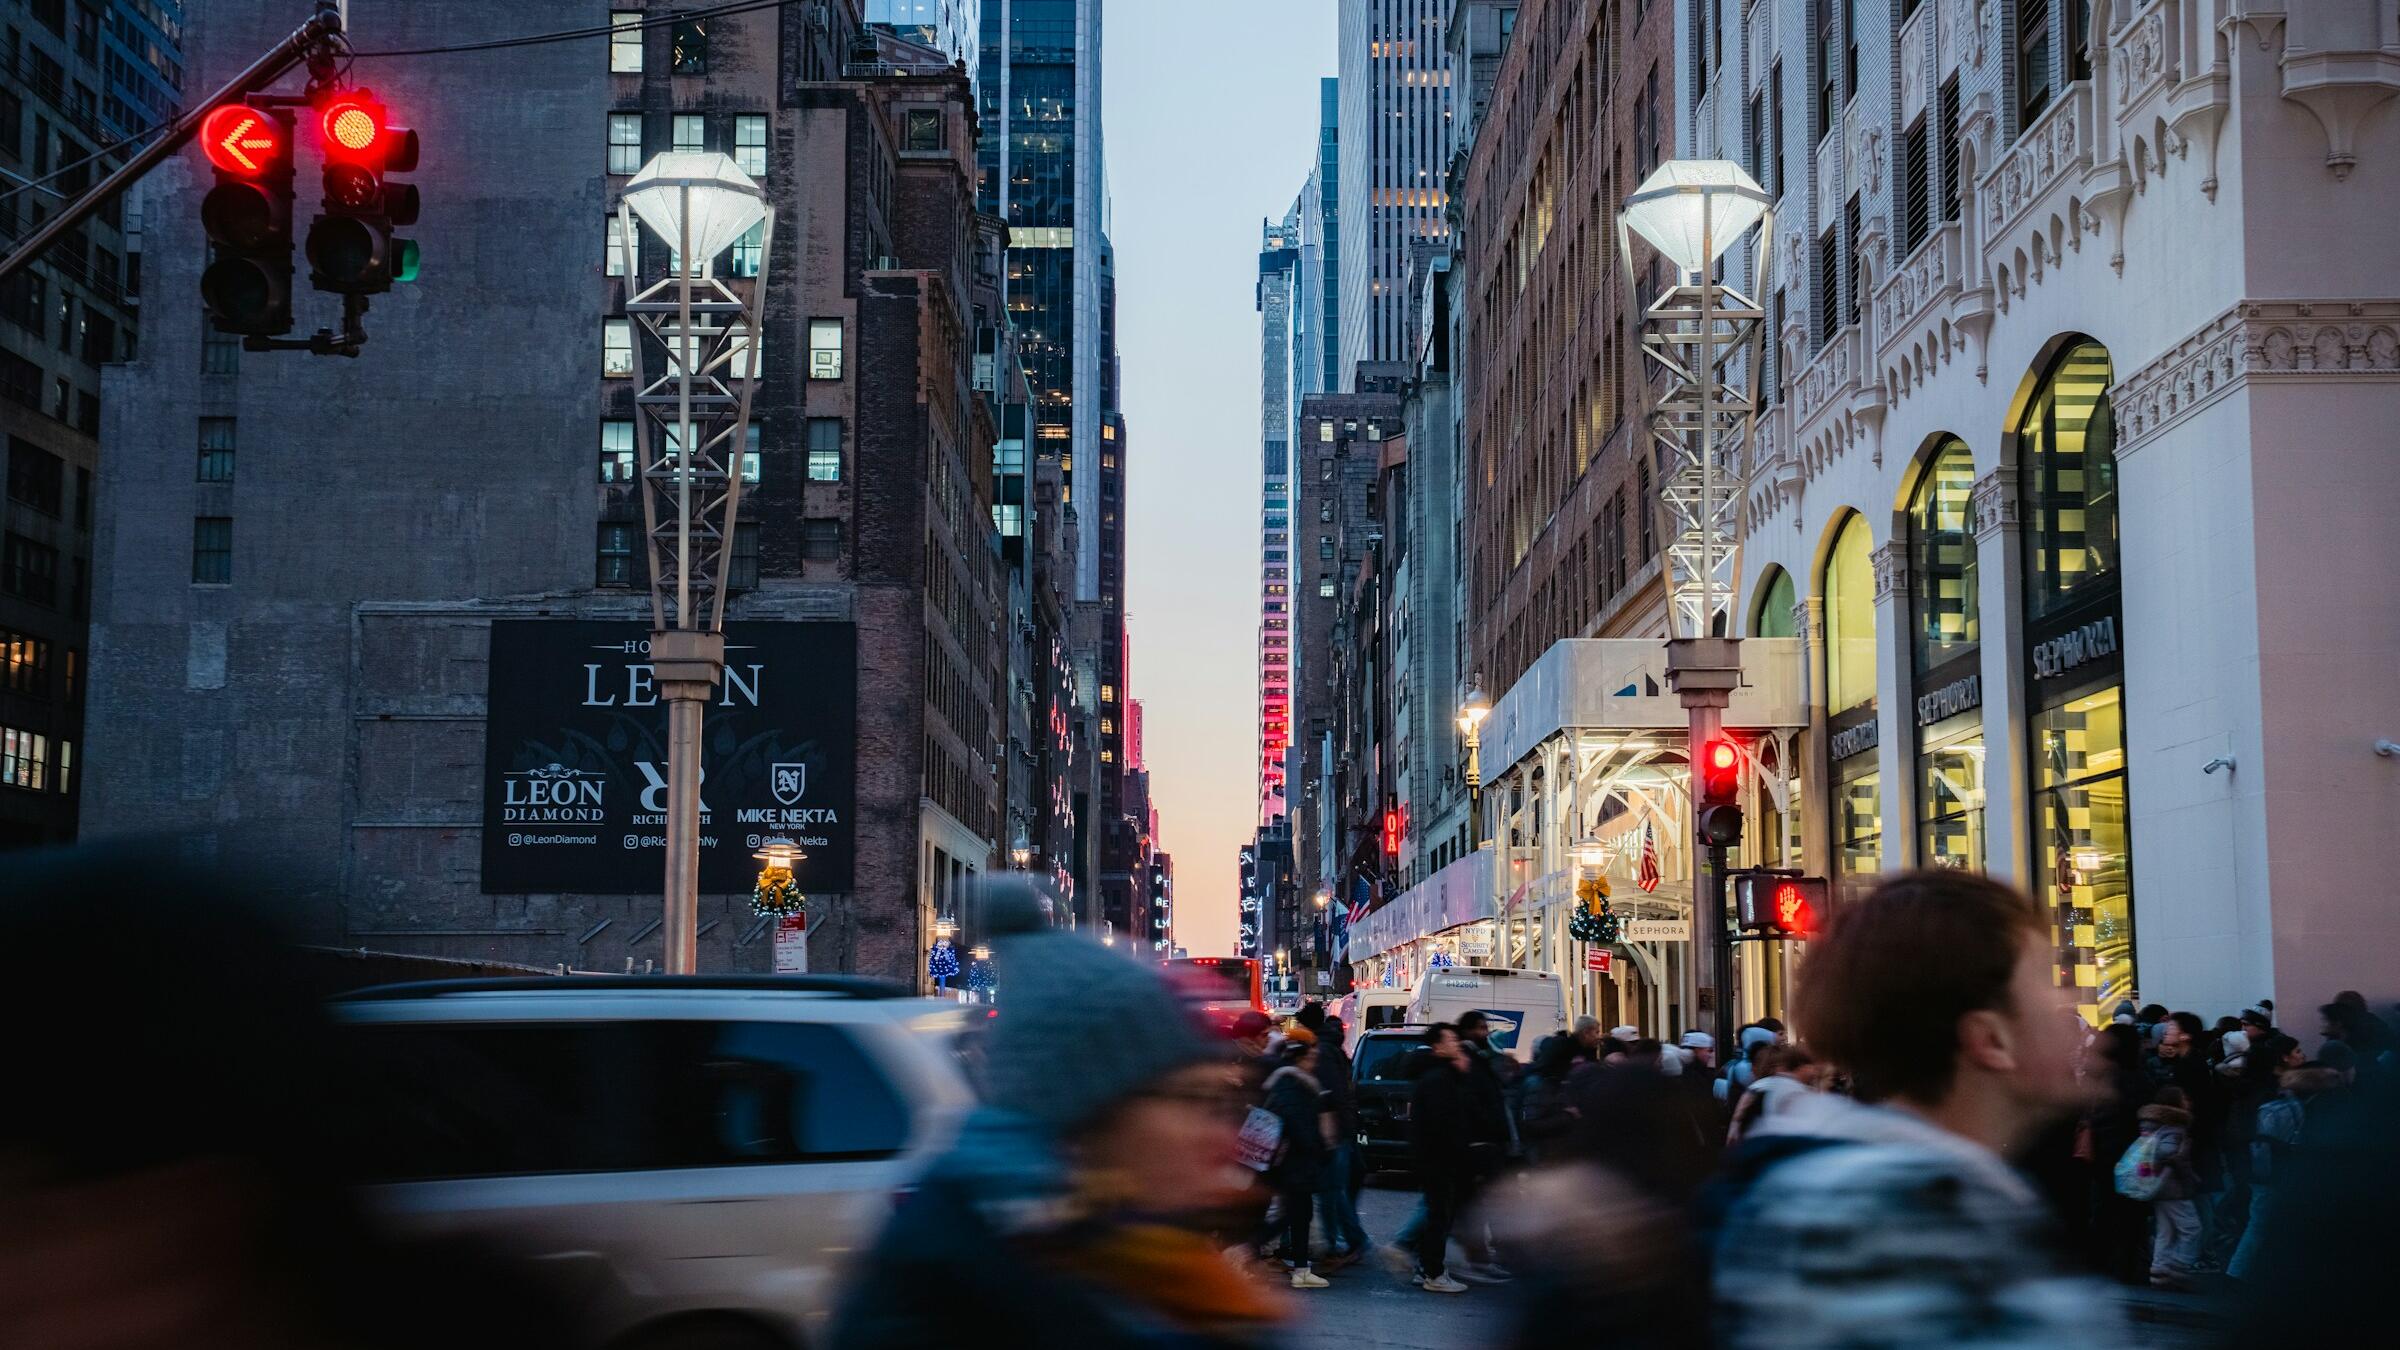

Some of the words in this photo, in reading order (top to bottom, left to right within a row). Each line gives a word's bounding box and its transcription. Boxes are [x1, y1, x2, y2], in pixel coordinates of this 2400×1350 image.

[2033, 616, 2116, 681] SEPHORA
[582, 664, 764, 706] LEN
[1918, 674, 1979, 727] SEPHORA
[504, 779, 606, 805] LEON
[504, 807, 604, 821] DIAMOND
[737, 808, 777, 823] MIKE
[780, 808, 838, 823] NEKTA
[523, 834, 597, 845] @LeonDiamond
[1633, 926, 1685, 935] SEPHORA
[1461, 941, 1489, 949] SECURITY
[1462, 947, 1488, 955] CAMERA
